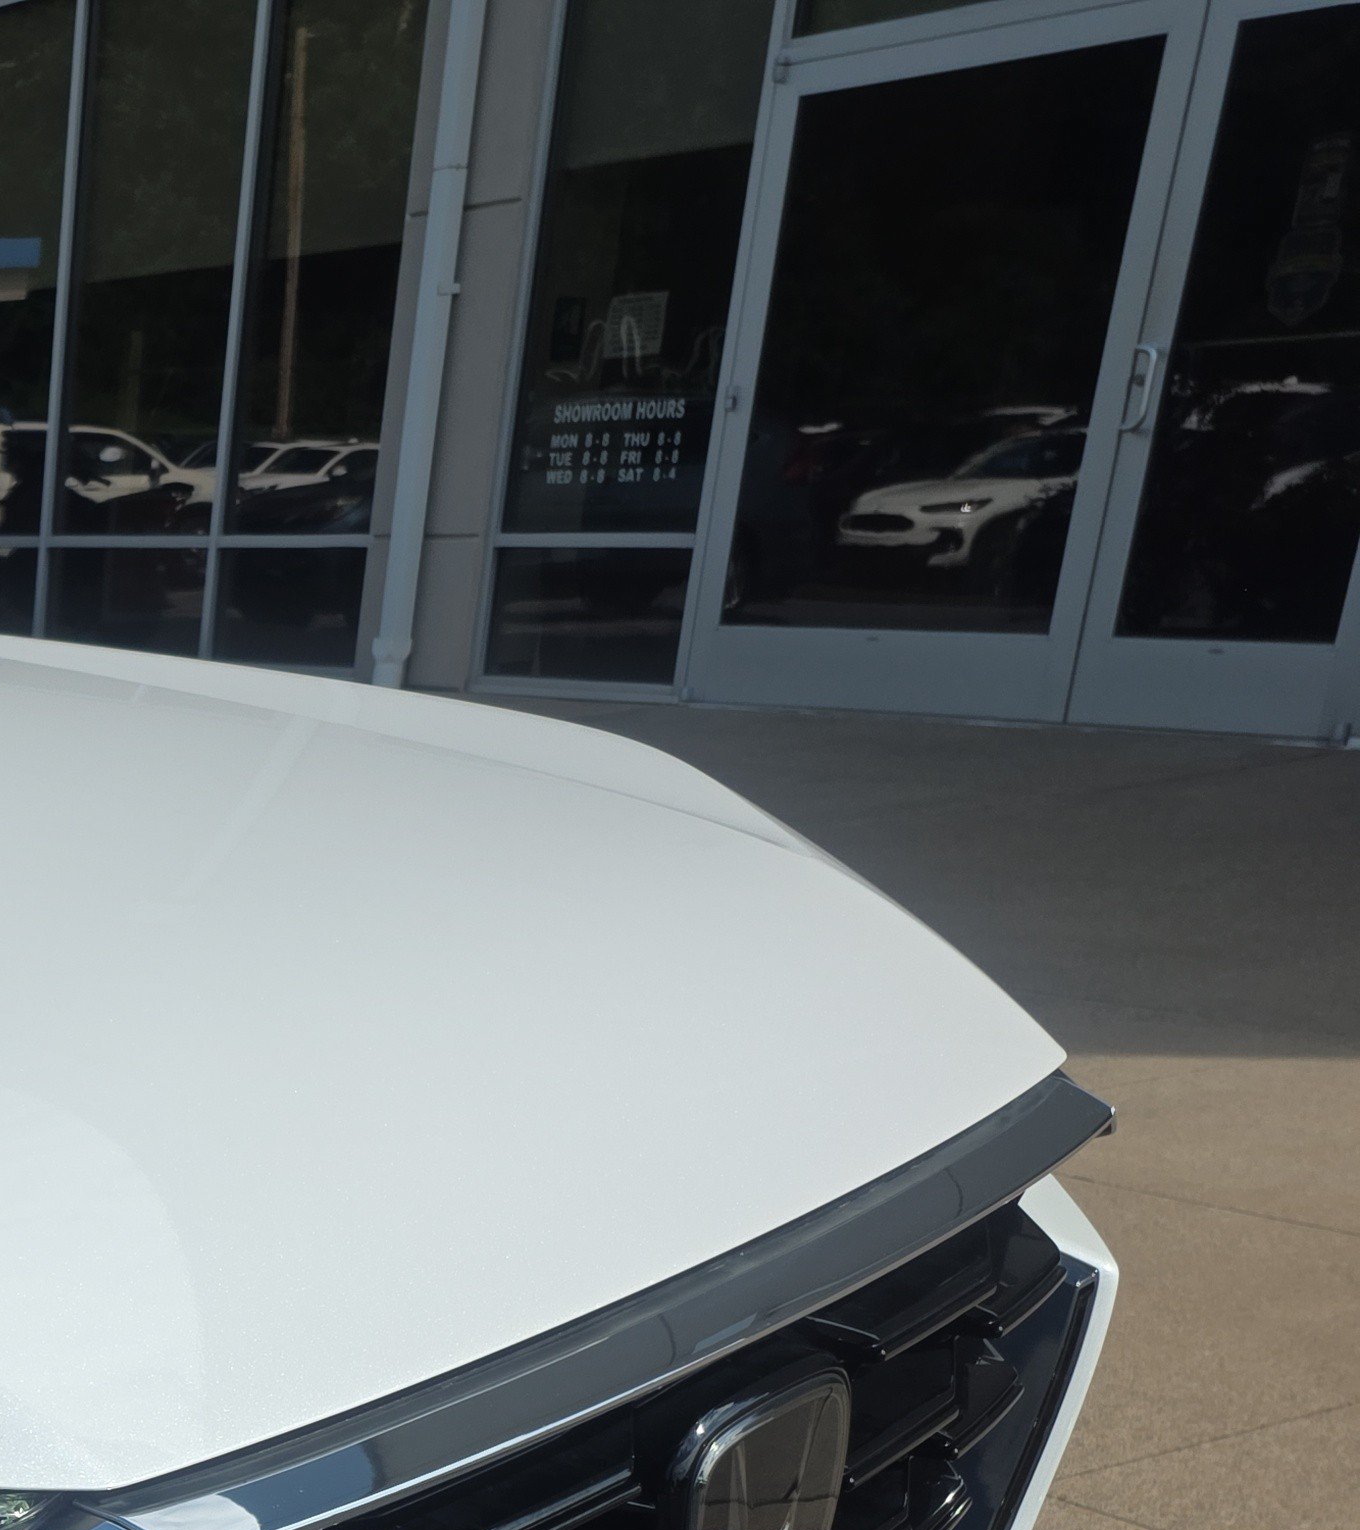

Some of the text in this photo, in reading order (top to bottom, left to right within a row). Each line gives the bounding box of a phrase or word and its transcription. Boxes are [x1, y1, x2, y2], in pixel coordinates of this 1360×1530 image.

[554, 398, 686, 424] SHOWROOM HOURS
[549, 433, 579, 449] MON
[623, 432, 651, 448] THU
[548, 451, 574, 467] TUE
[620, 449, 642, 465] FRI
[545, 468, 574, 485] WED
[617, 467, 645, 483] SAT
